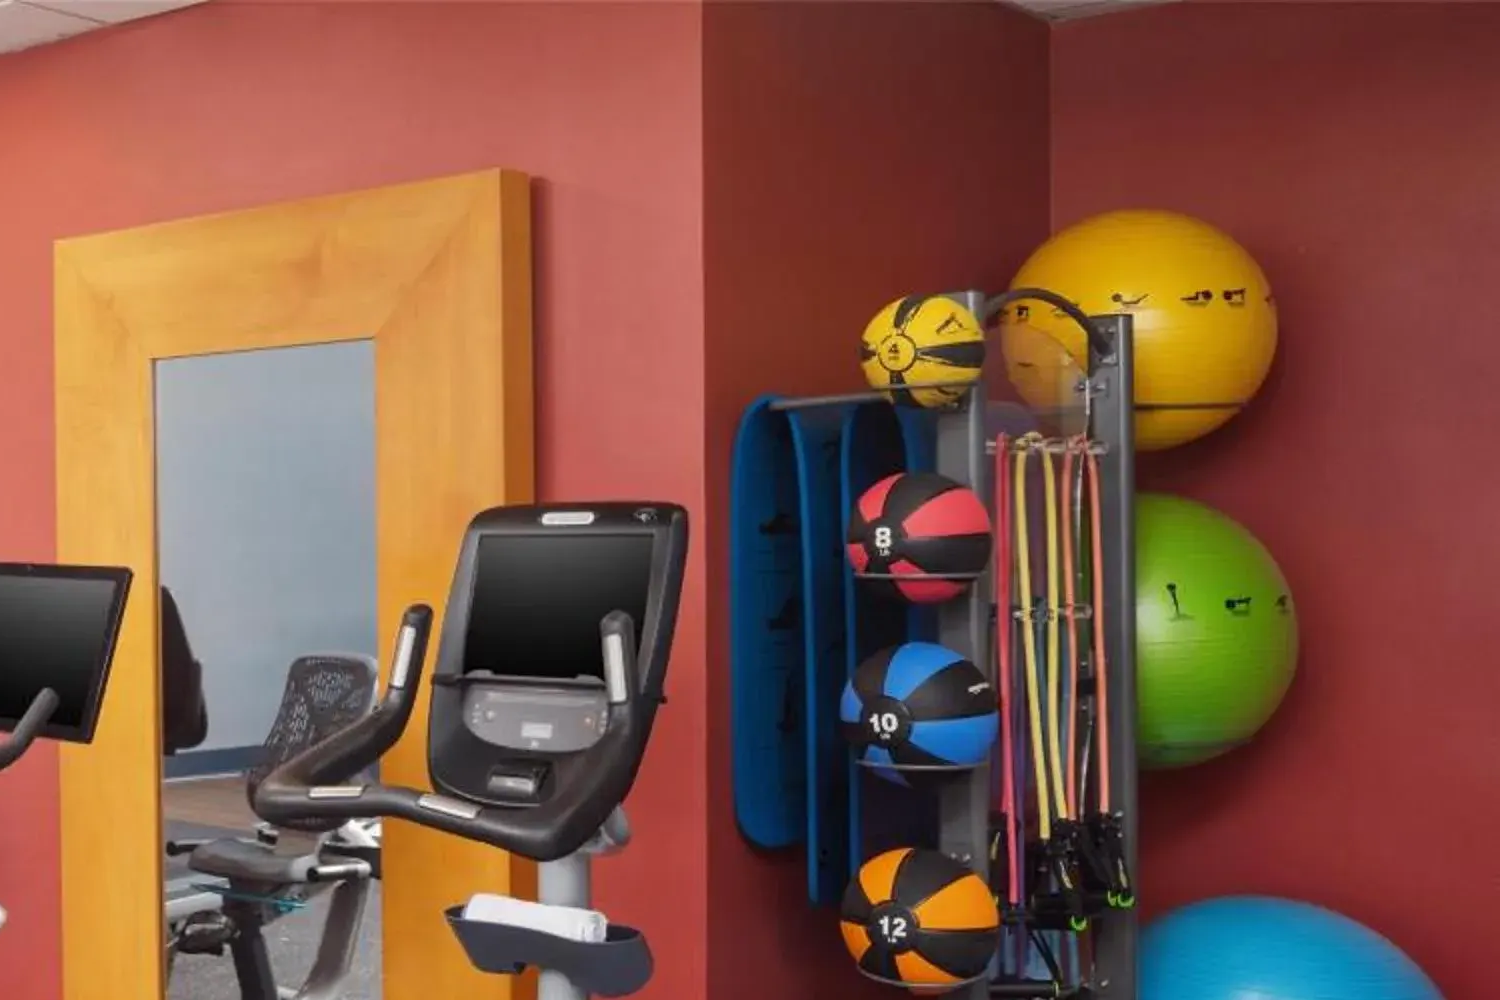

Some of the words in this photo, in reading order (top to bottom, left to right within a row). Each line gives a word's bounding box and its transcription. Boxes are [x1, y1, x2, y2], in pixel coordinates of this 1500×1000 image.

[875, 527, 891, 548] 8
[869, 713, 898, 732] 10
[879, 915, 907, 937] 12
